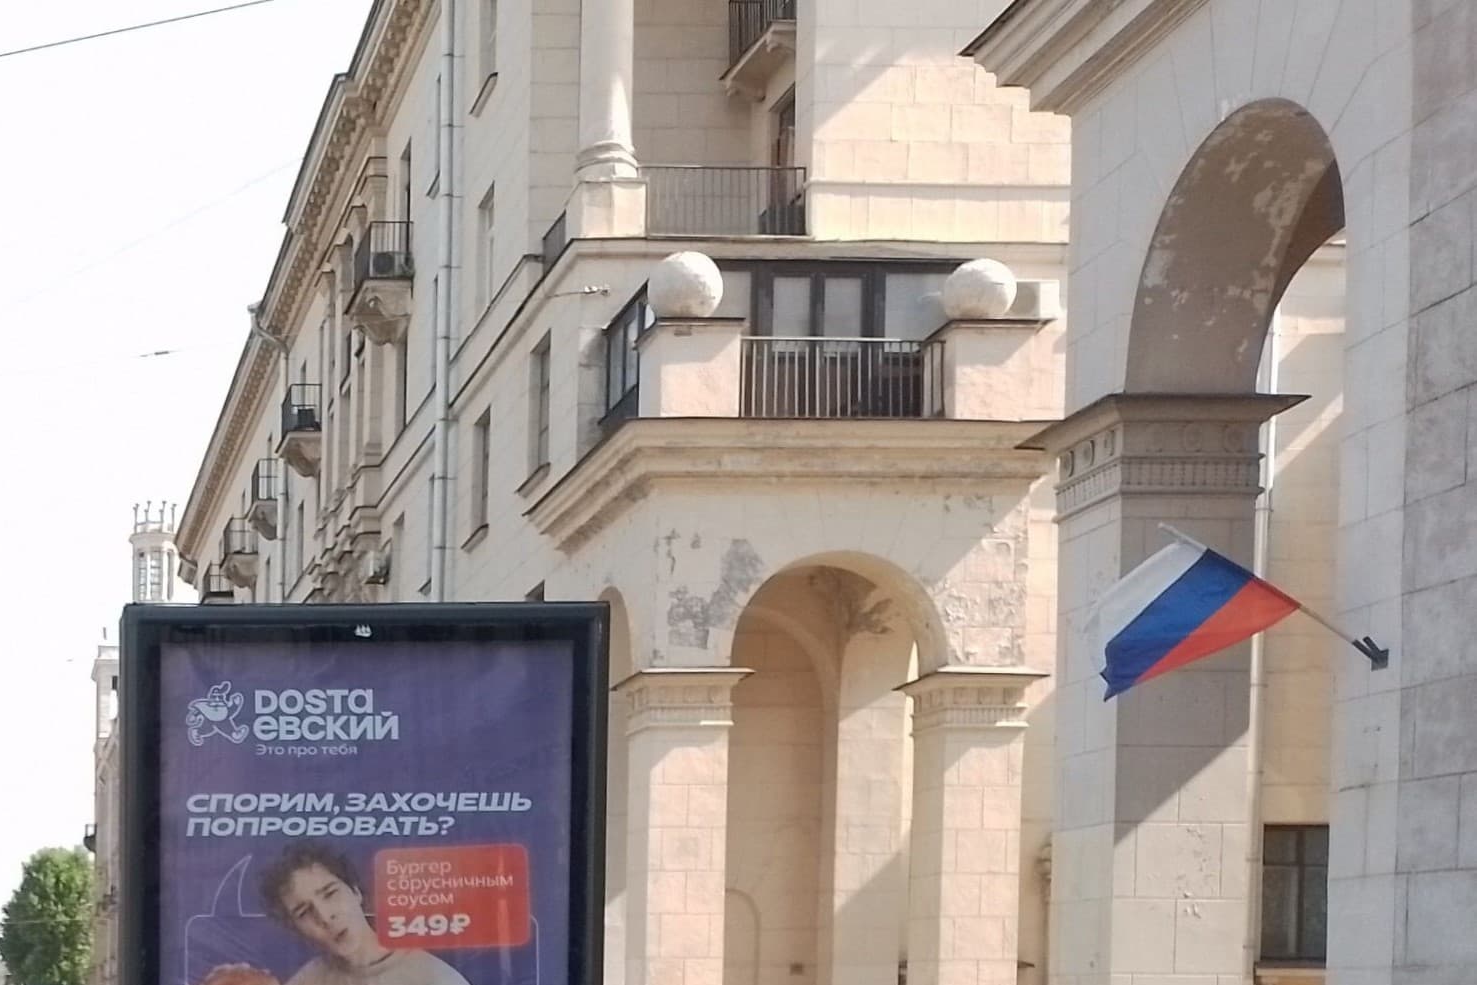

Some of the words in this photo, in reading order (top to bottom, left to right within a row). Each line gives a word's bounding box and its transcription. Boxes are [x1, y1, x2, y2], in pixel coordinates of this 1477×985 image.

[255, 744, 285, 755] Это
[288, 746, 318, 758] про
[321, 744, 358, 755] тебя
[186, 792, 340, 815] СПОРИМ,
[345, 792, 532, 812] ЗАХОЧЕШЬ
[186, 816, 455, 837] ПОПРОБОВАТЬ?
[386, 860, 452, 875] Бургер
[386, 881, 397, 891] с
[398, 874, 514, 893] брусничным
[387, 893, 454, 910] соусом
